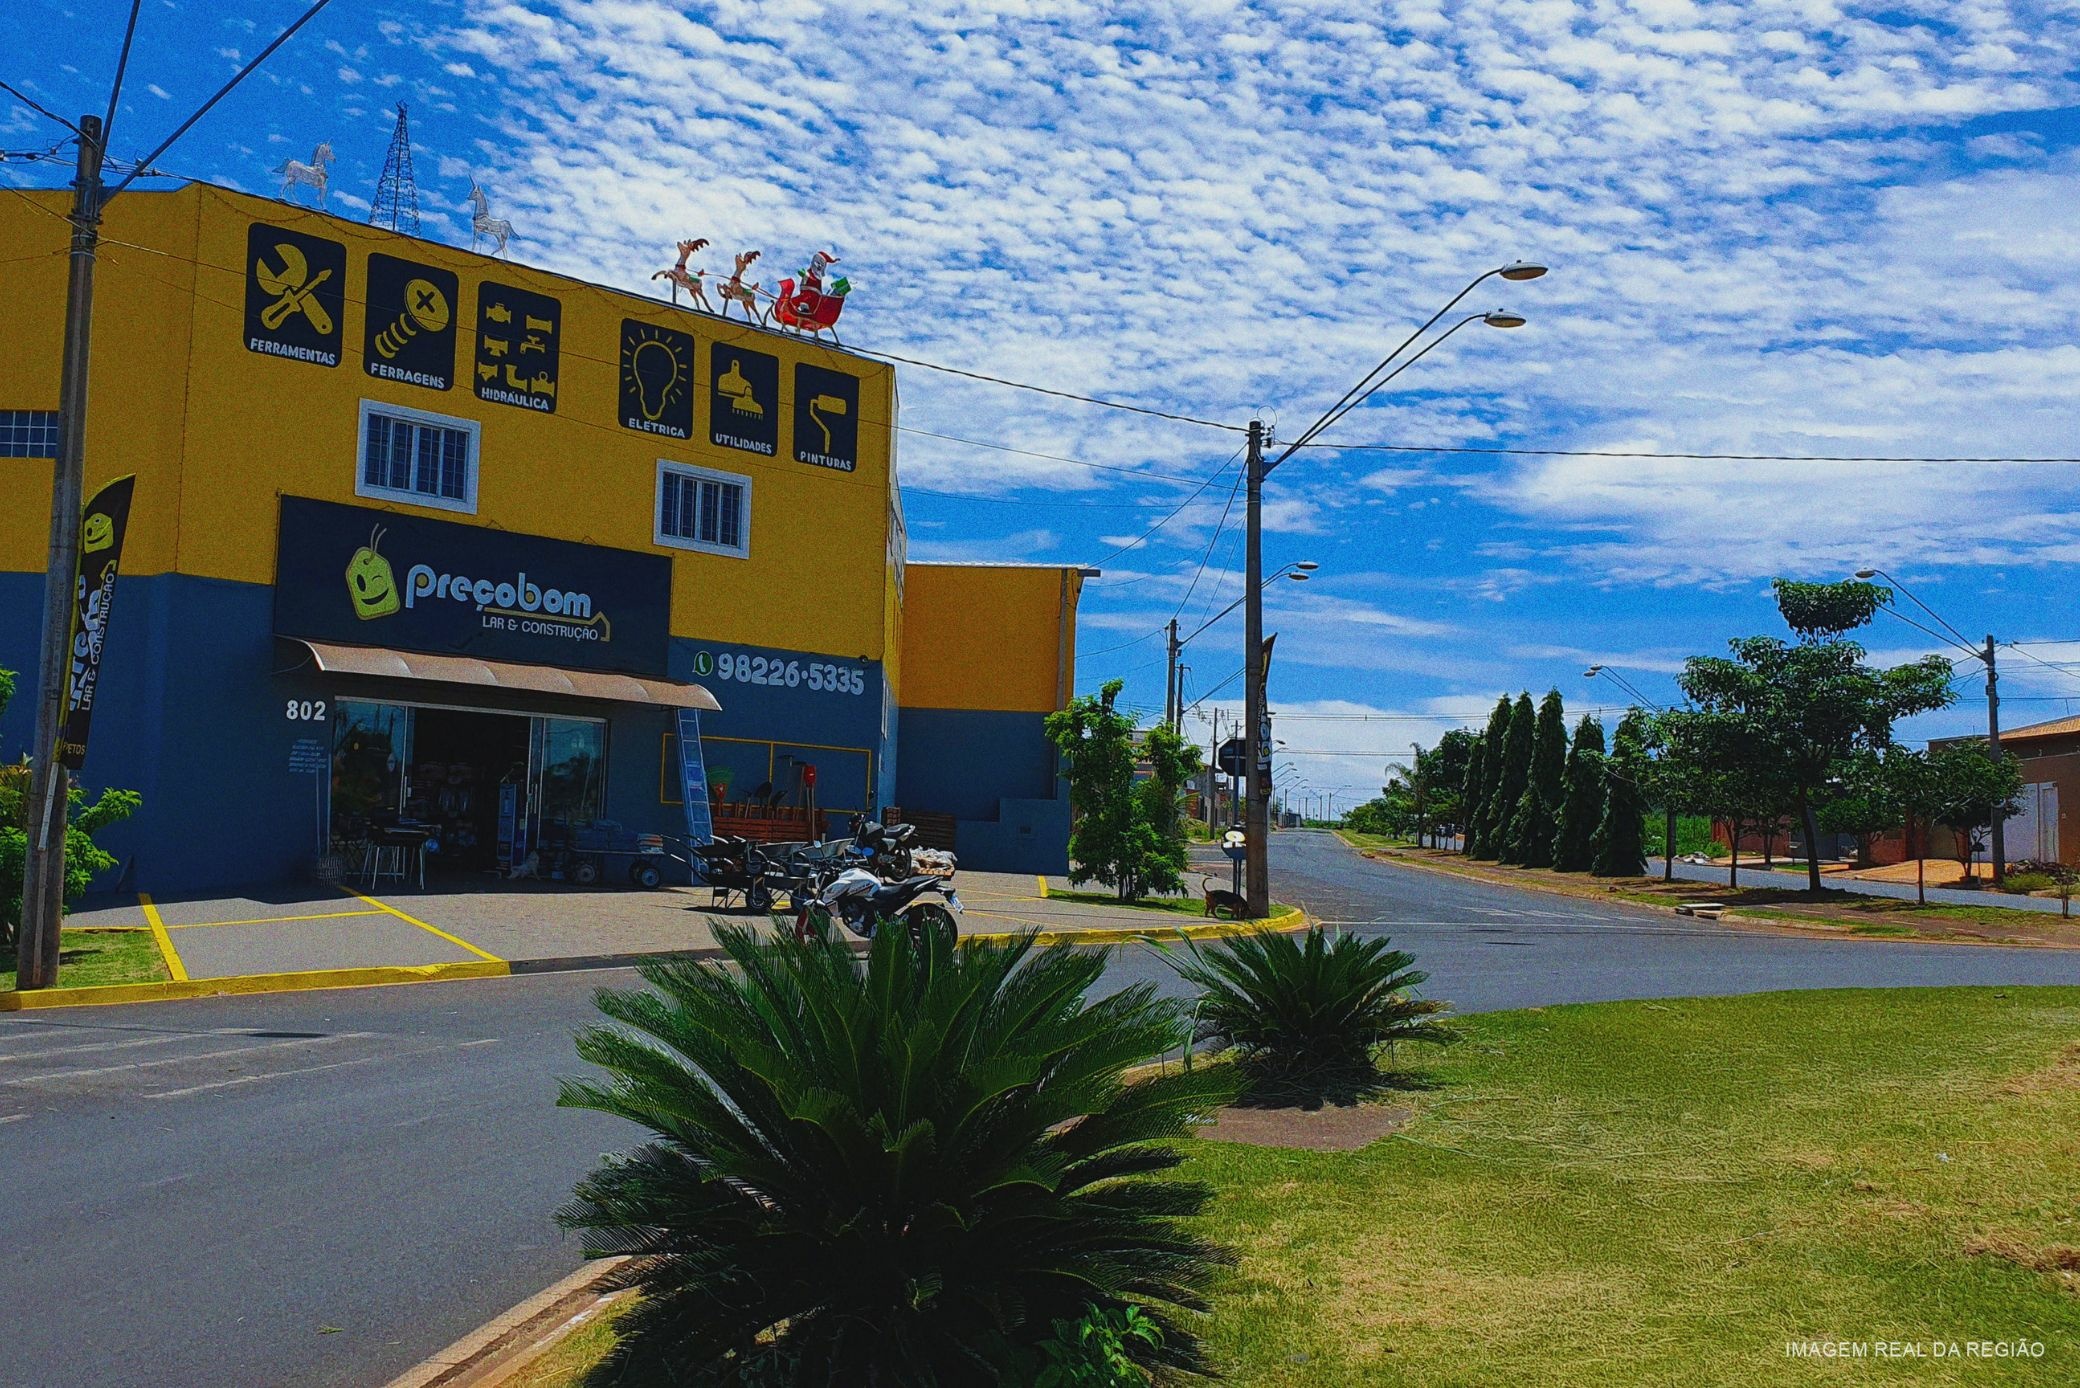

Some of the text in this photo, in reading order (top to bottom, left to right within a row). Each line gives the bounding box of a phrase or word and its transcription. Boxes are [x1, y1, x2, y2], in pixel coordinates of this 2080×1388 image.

[250, 338, 335, 365] FERRAMENTAS
[371, 363, 445, 389] FERRAGENS
[481, 387, 549, 411] HIDRÁULICA
[628, 417, 685, 438] ELÉTRICA
[715, 433, 772, 454] UTILIDADES
[800, 451, 851, 471] PINTURAS
[482, 616, 599, 642] LAR & CONSTRUÇÃO
[87, 669, 97, 682] &
[81, 685, 94, 711] LAR
[286, 699, 326, 720] 802
